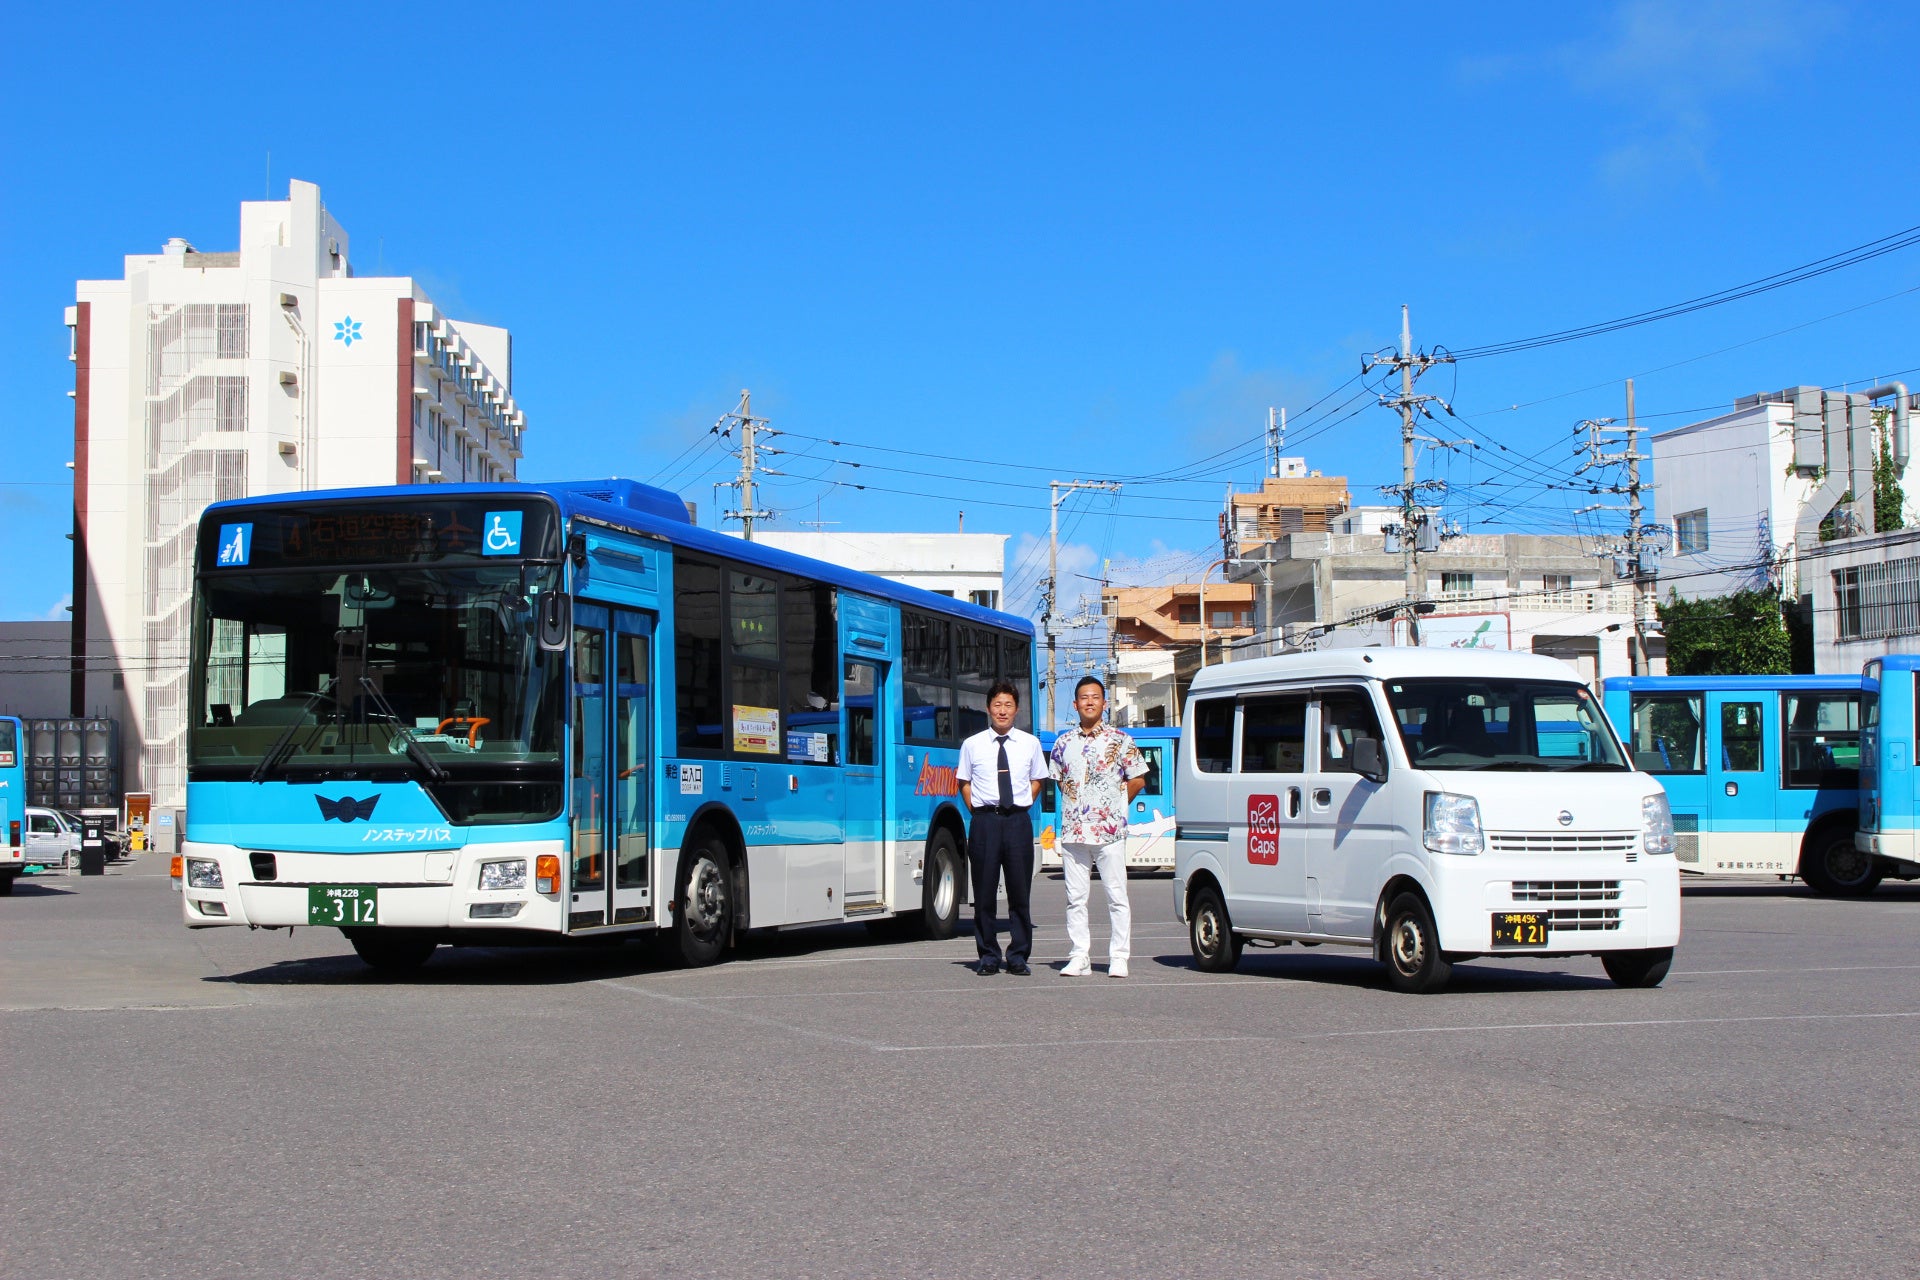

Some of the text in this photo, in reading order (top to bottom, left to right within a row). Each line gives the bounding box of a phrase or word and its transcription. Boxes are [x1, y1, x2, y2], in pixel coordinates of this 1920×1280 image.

[681, 768, 702, 782] 出入口
[1250, 810, 1277, 834] Red
[362, 827, 451, 842] ノンステップバス
[1250, 836, 1276, 858] Caps
